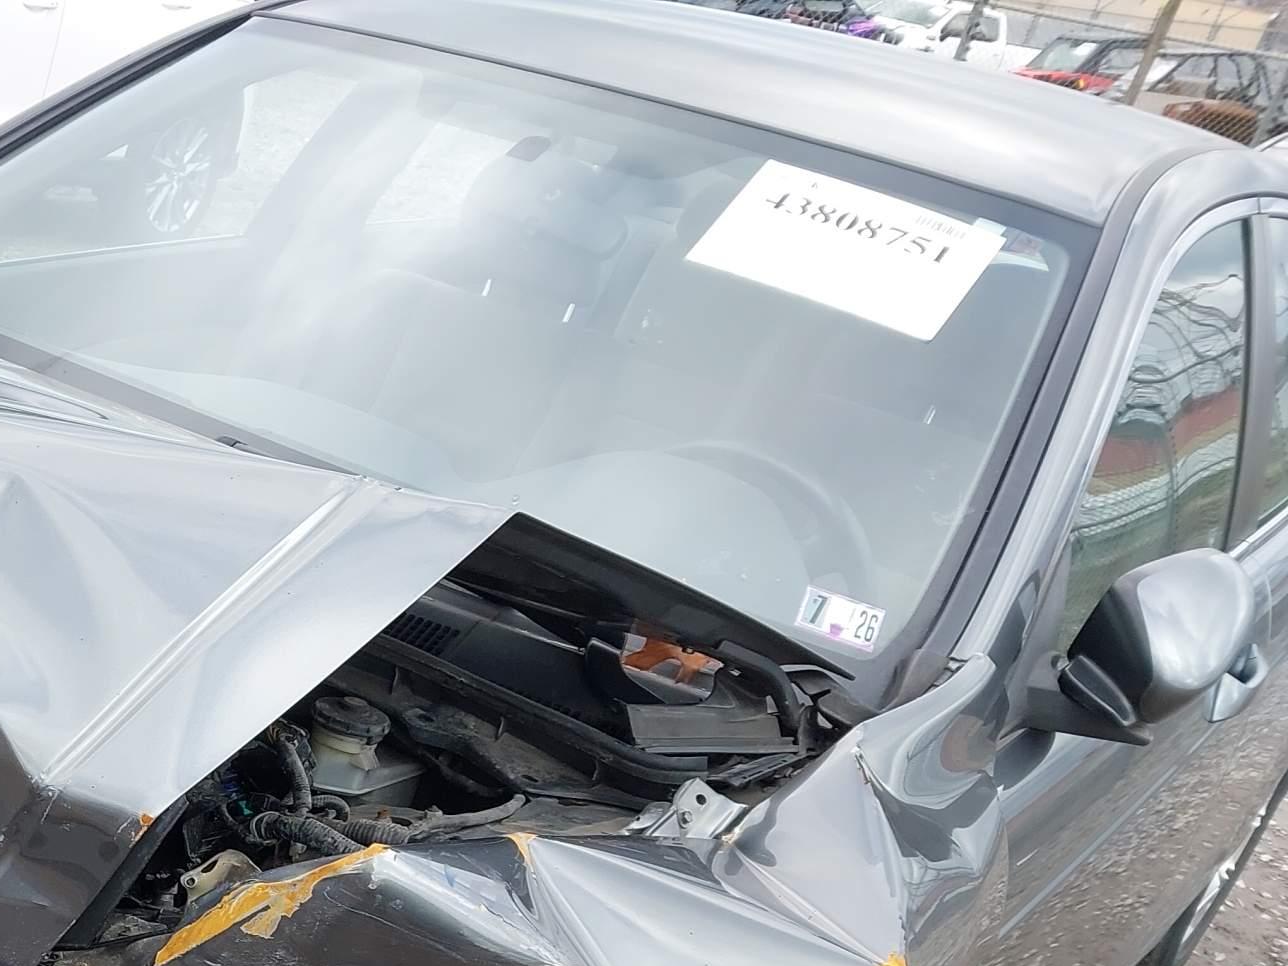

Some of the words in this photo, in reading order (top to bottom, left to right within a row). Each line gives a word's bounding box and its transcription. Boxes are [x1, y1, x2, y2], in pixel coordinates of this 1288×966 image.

[765, 192, 950, 264] 43808751
[809, 594, 829, 625] 7
[853, 609, 879, 643] 26
